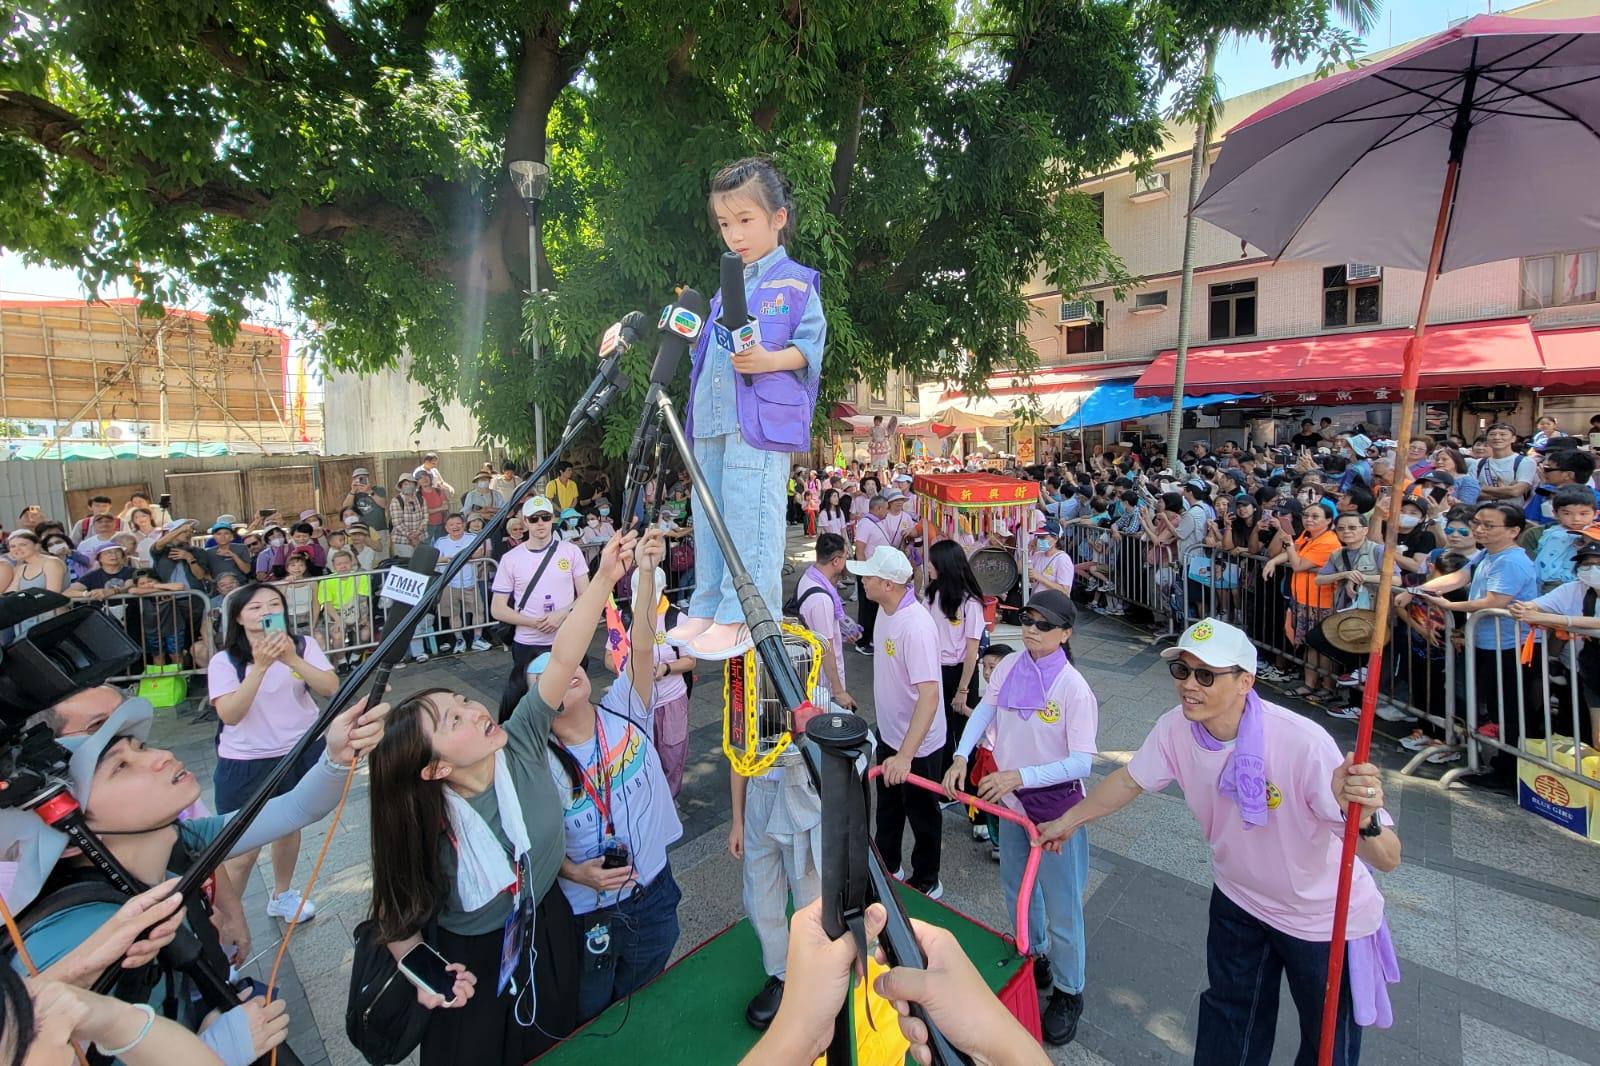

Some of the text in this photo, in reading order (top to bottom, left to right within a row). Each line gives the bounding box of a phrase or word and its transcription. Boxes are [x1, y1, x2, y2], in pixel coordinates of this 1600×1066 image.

[741, 339, 756, 349] TVB
[961, 486, 1027, 501] 新興街
[1531, 796, 1551, 810] BLUE
